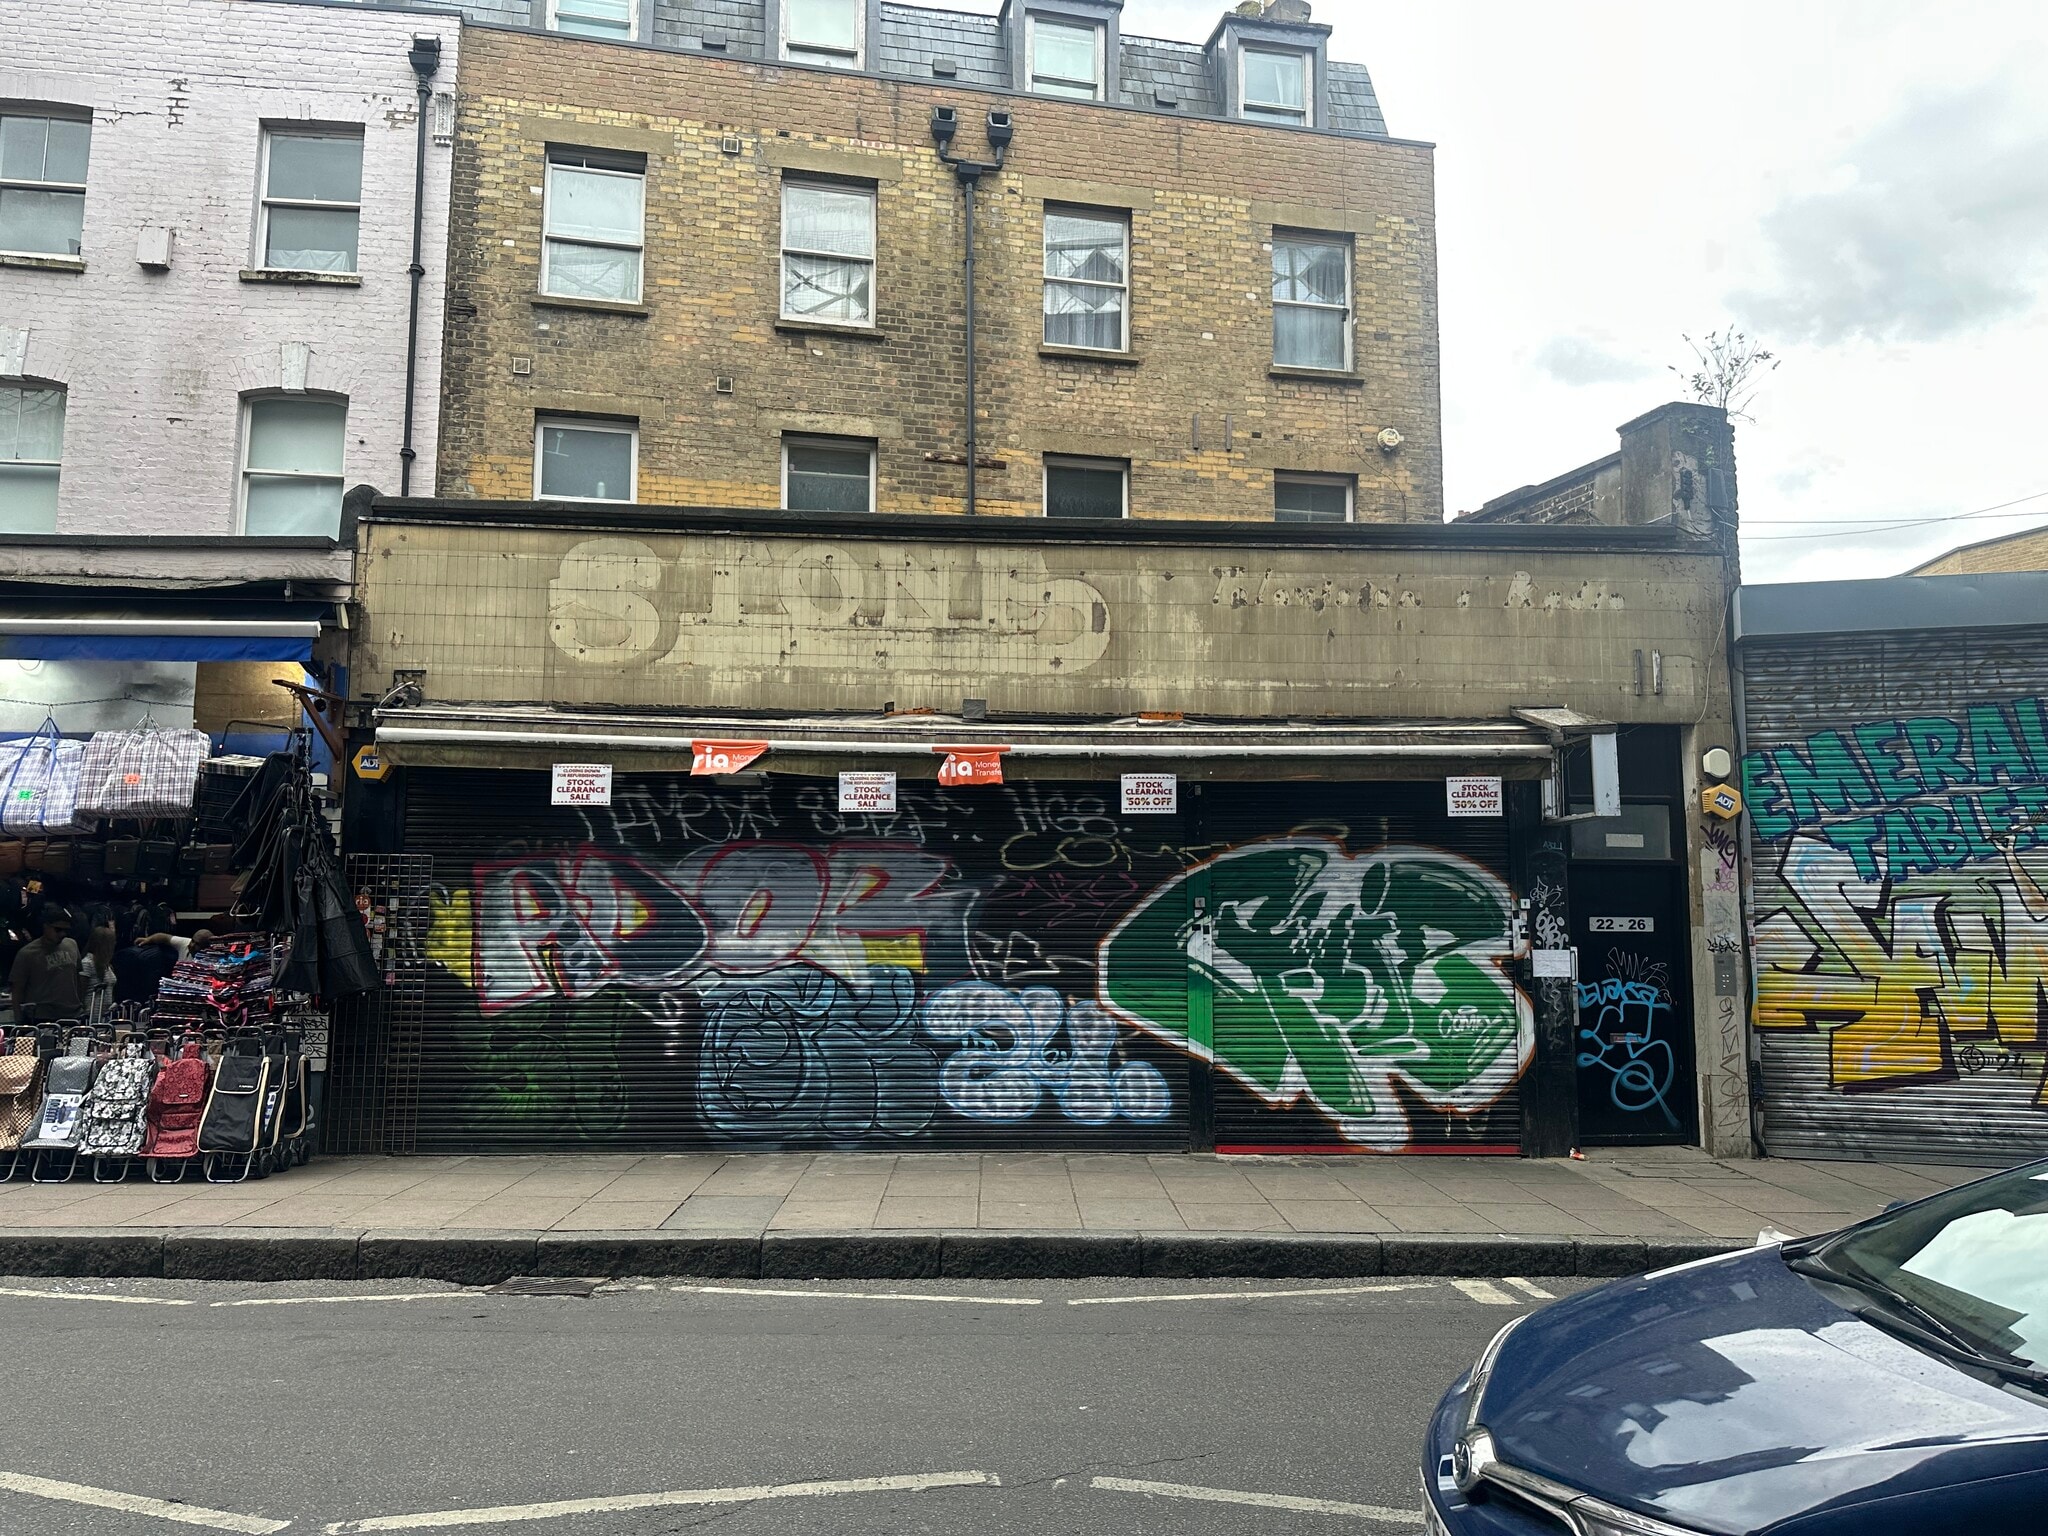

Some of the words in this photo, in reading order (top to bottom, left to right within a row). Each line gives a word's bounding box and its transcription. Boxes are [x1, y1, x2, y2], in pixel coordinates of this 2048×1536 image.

[693, 747, 729, 768] ria
[940, 755, 973, 777] ria
[975, 761, 1001, 769] Money
[556, 786, 606, 794] CLEARANCE
[1125, 788, 1173, 796] CLEARANCE
[1128, 797, 1151, 806] 50%
[1152, 797, 1172, 806] OFF
[1454, 800, 1477, 808] 50%
[1479, 800, 1498, 808] OFF
[1715, 795, 1736, 808] ADT
[1596, 918, 1614, 930] 22
[1628, 918, 1646, 930] 26
